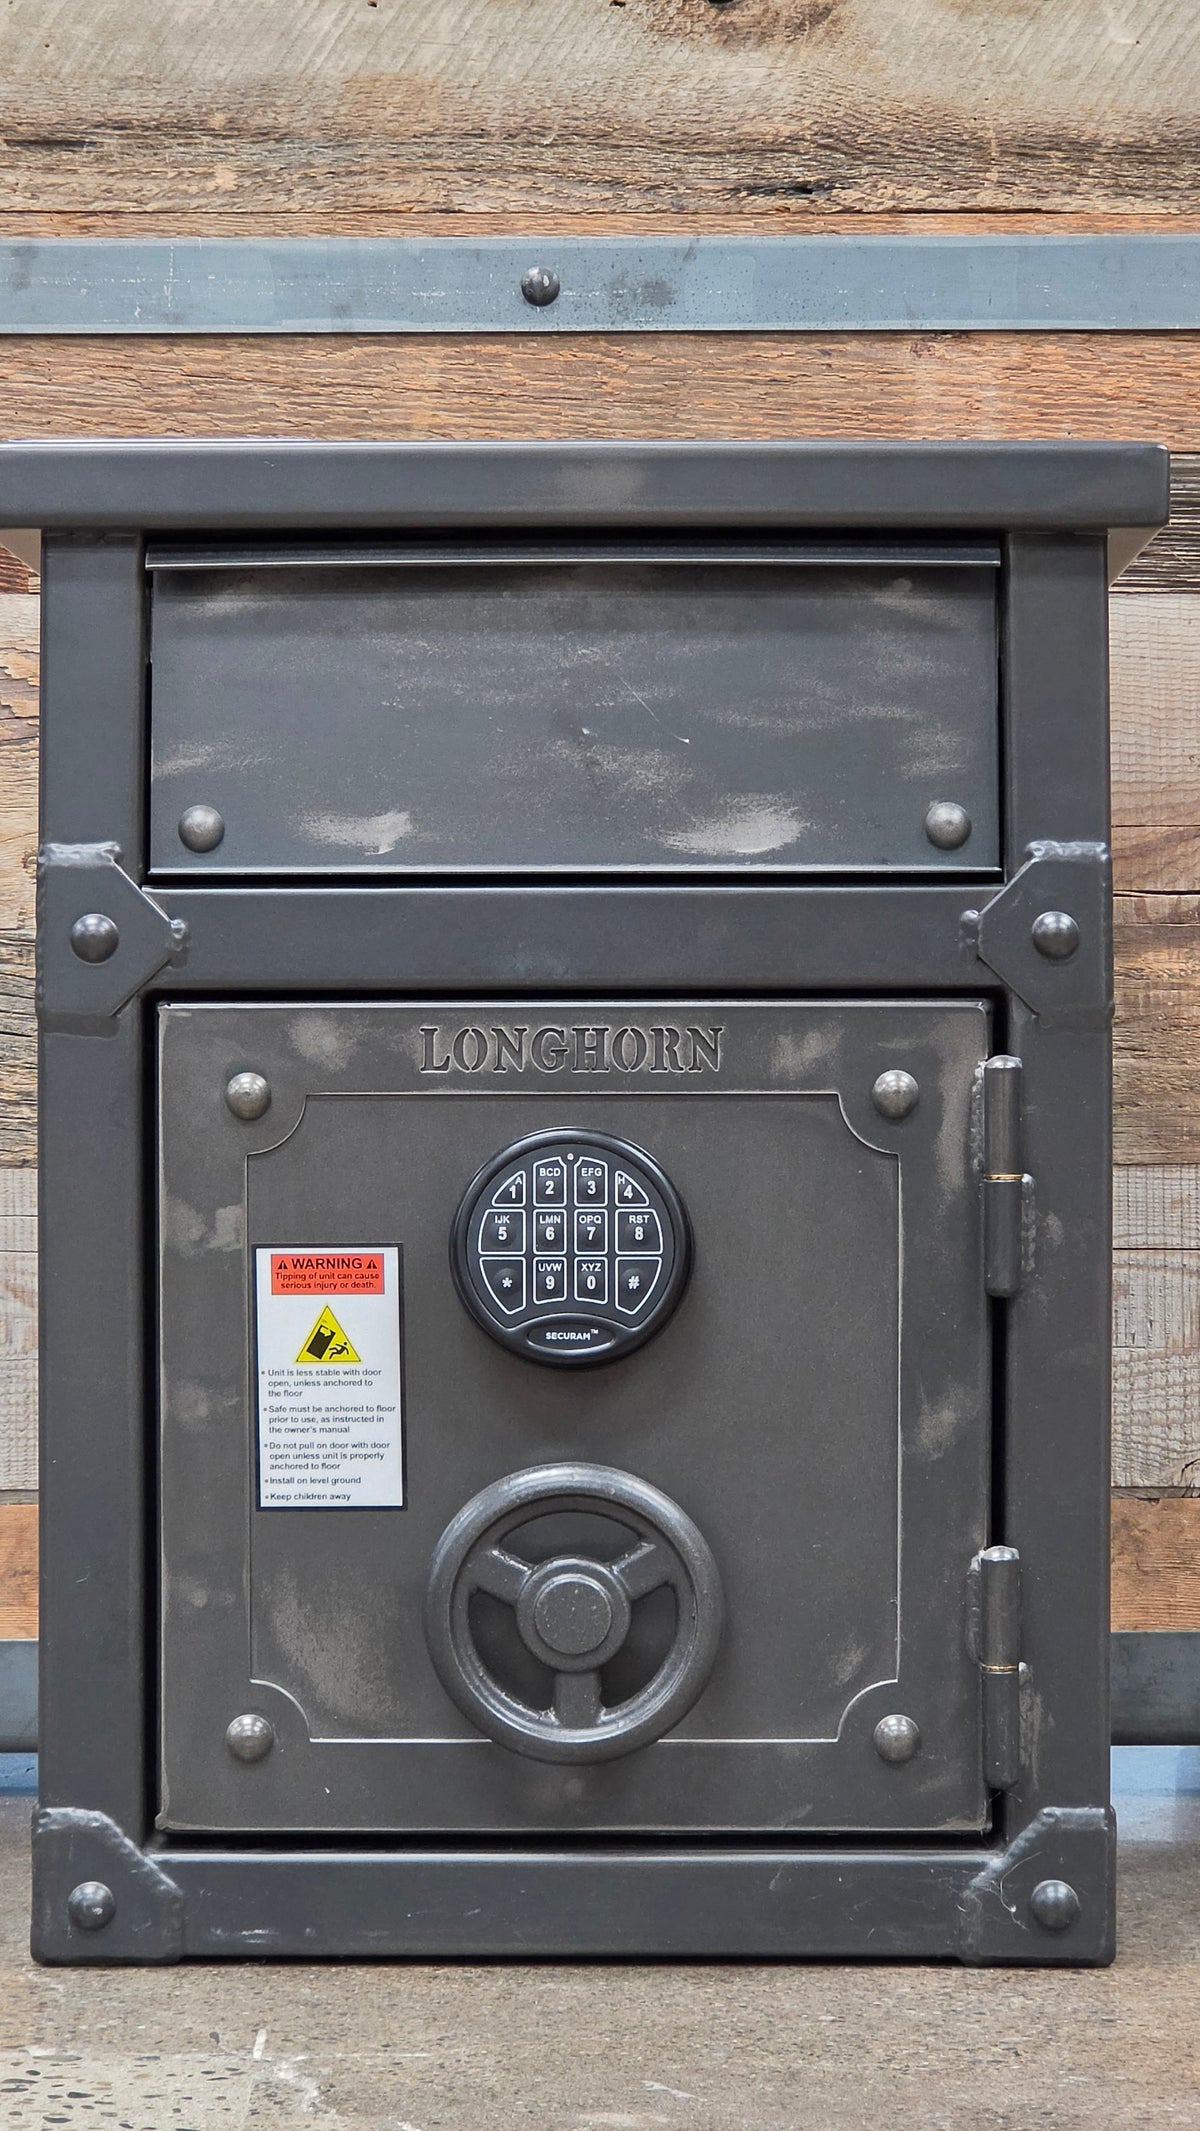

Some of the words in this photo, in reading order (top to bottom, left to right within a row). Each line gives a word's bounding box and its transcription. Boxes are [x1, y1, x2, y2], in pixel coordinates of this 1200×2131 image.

[419, 1026, 725, 1073] LONGHORN
[540, 1168, 561, 1177] BCD
[582, 1168, 602, 1177] EFG
[509, 1185, 516, 1199] 1
[545, 1181, 554, 1194] 2
[588, 1181, 596, 1194] 3
[624, 1185, 633, 1199] 4
[579, 1216, 602, 1224] OPQ
[498, 1227, 507, 1240] 5
[546, 1227, 554, 1240] 6
[587, 1227, 596, 1240] 7
[635, 1227, 643, 1240] 8
[292, 1258, 362, 1270] WARNING
[539, 1264, 562, 1272] UVW
[581, 1264, 601, 1272] XYZ
[276, 1272, 306, 1281] Tipping
[546, 1276, 554, 1290] 9
[587, 1276, 596, 1290] 0
[331, 1477, 361, 1485] ground
